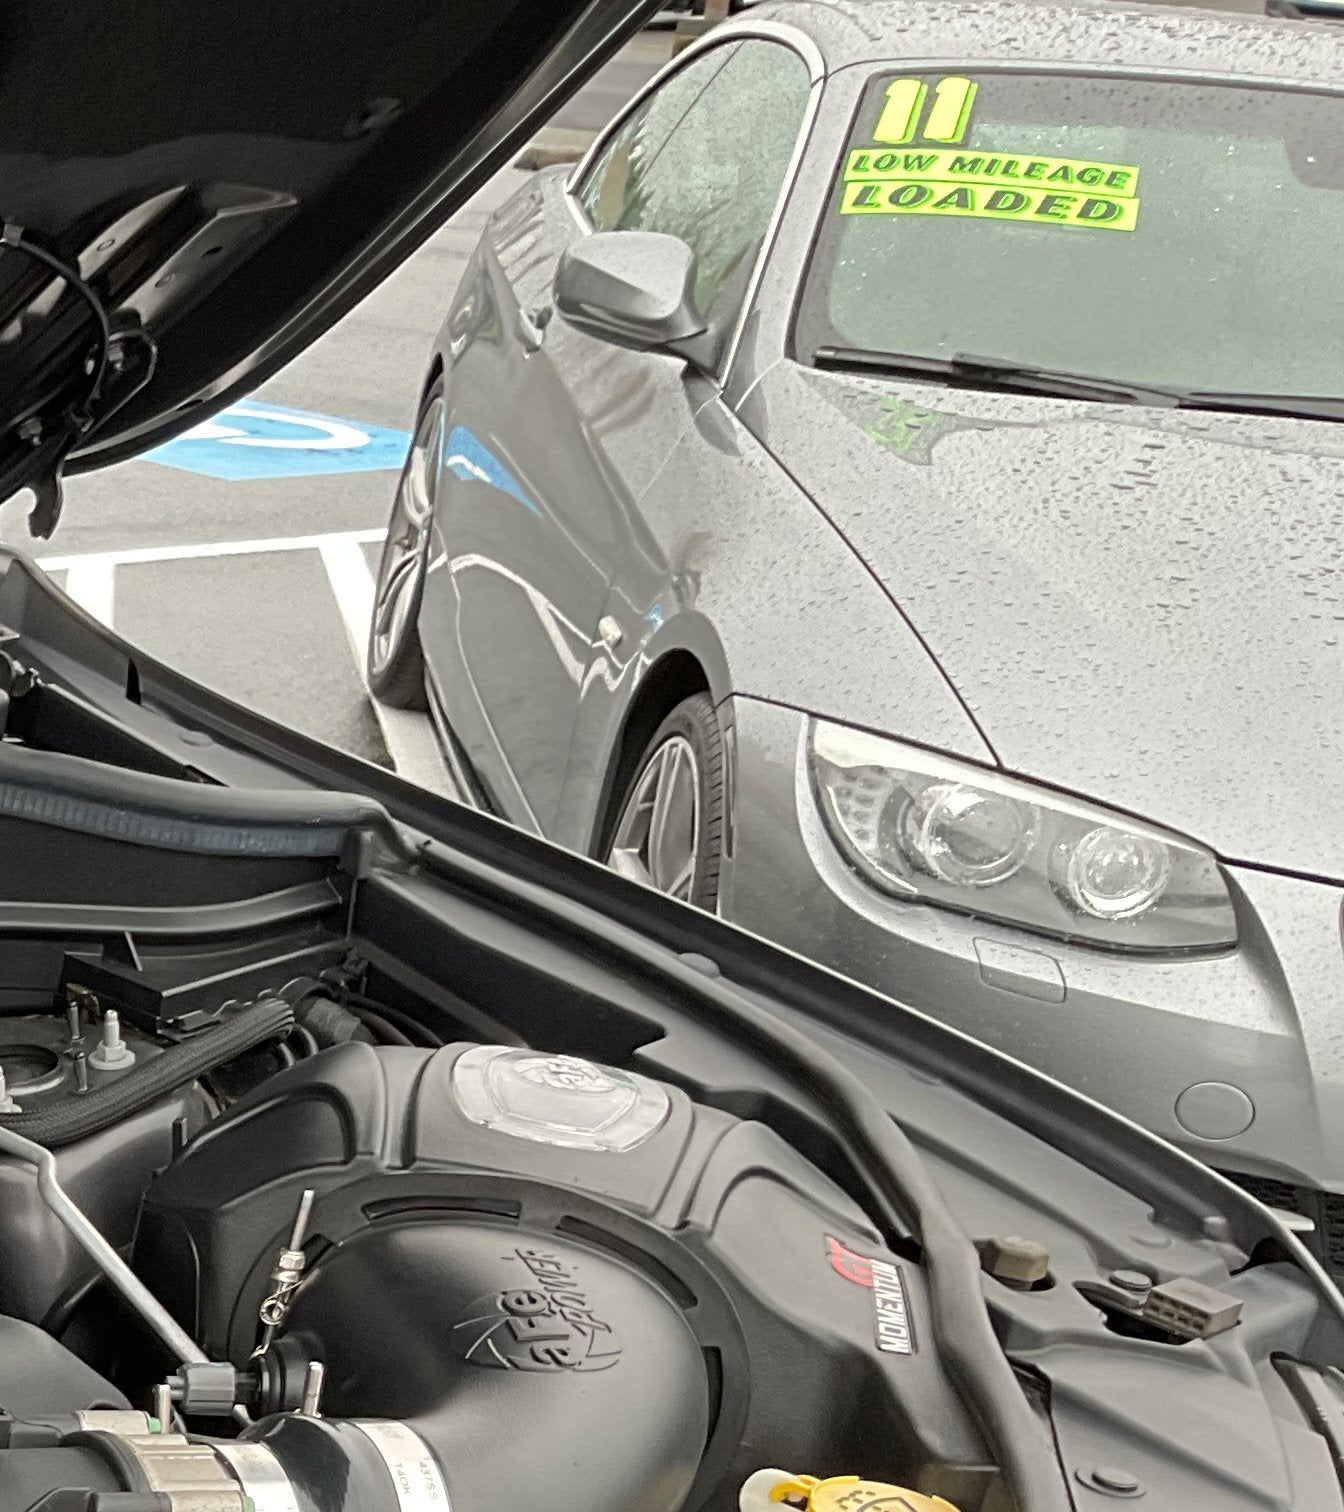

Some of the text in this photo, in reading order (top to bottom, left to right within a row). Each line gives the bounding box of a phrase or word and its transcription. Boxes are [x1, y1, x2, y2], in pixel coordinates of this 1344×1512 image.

[872, 74, 979, 145] 11
[852, 153, 1133, 191] LOW MILEAGE
[851, 184, 1124, 223] LOADED
[870, 1258, 912, 1354] MOMENTUM
